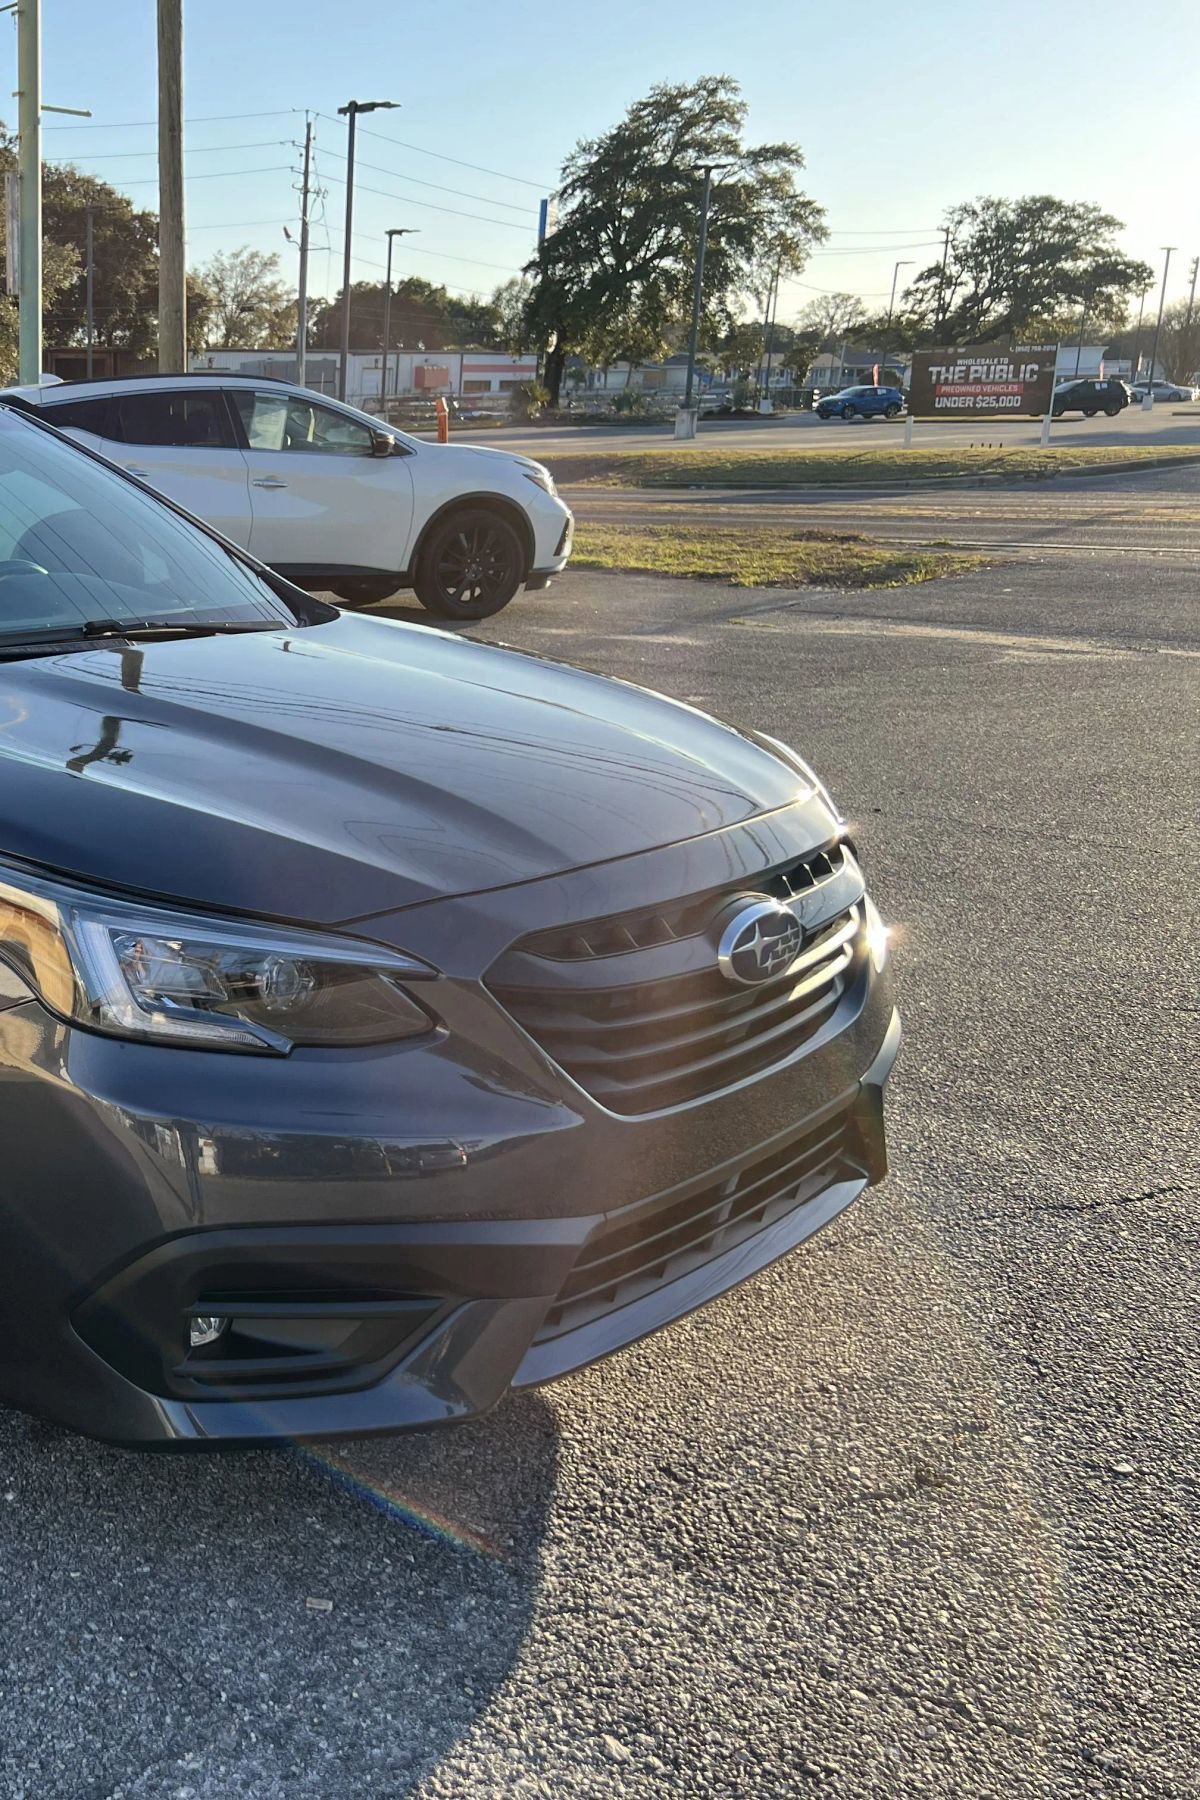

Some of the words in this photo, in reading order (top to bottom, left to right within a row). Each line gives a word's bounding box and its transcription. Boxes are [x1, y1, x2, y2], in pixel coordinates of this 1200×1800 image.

[928, 366, 966, 384] THE
[968, 363, 1039, 383] PUBLIC
[941, 385, 981, 393] PREOWNED
[982, 384, 1018, 392] VEHICLES
[935, 396, 973, 408] UNDER
[975, 395, 1021, 408] $25,000
